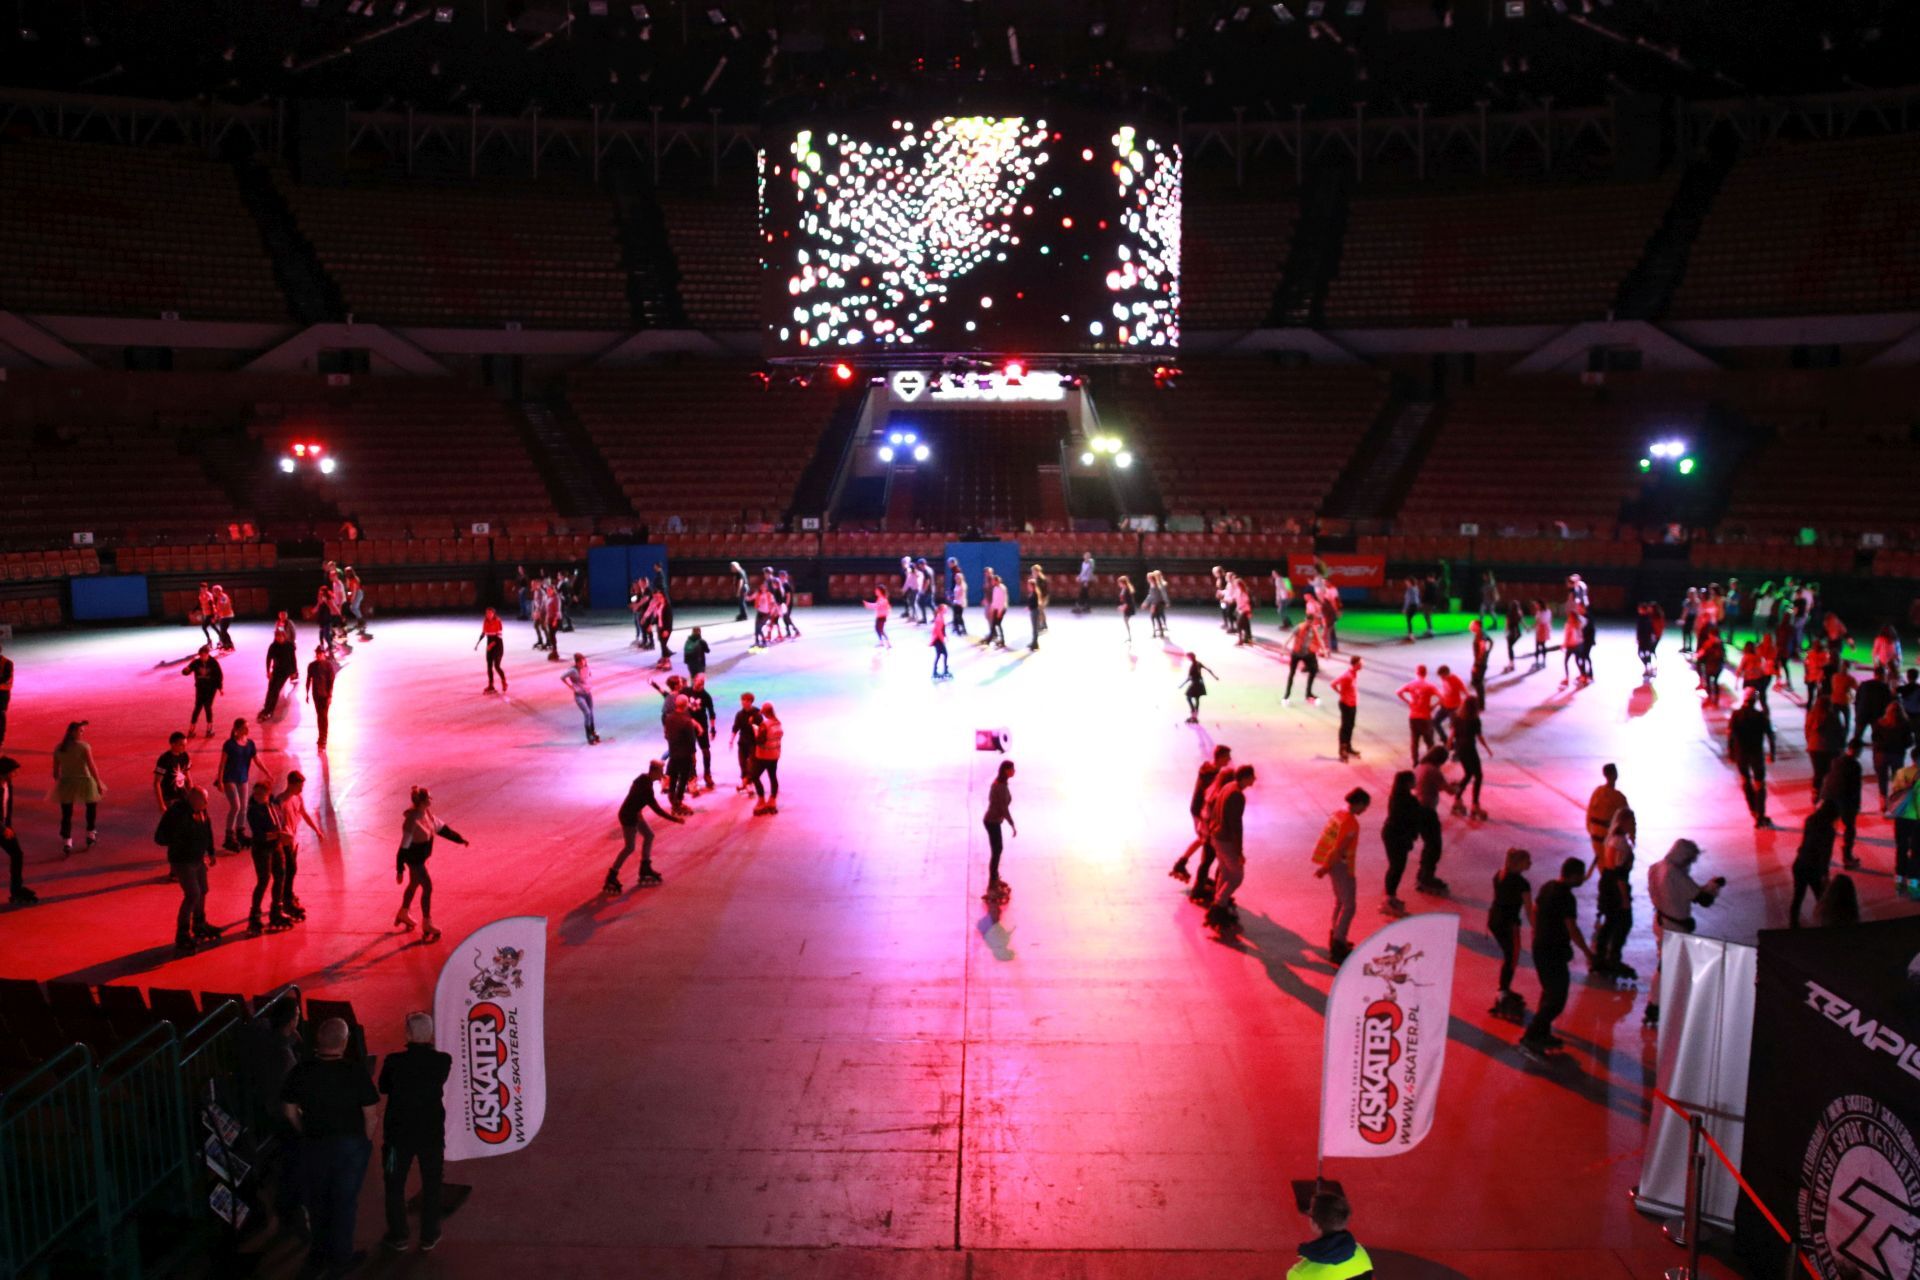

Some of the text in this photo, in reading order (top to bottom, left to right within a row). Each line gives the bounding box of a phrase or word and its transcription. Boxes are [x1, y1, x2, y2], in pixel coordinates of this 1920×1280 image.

[469, 1016, 502, 1134] 4SKATER
[509, 1007, 525, 1143] WWW.4SKATER.PL
[1358, 1016, 1392, 1132] 4SKATER
[1400, 1004, 1420, 1145] WWW.4SKATER.PL
[1811, 1145, 1838, 1222] TEMPISH
[1832, 1120, 1865, 1153] SPORT
